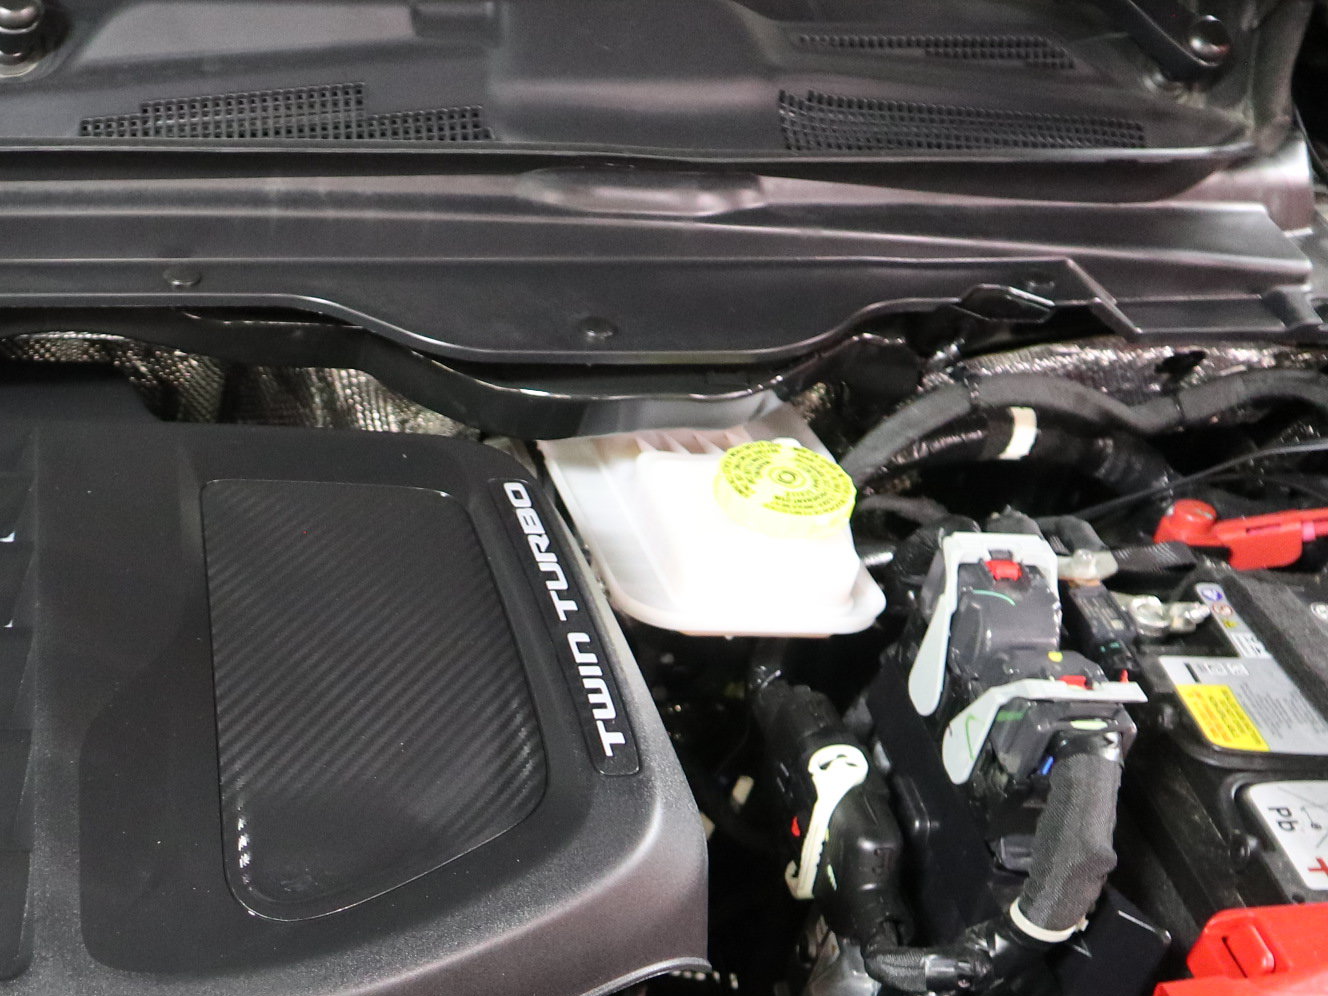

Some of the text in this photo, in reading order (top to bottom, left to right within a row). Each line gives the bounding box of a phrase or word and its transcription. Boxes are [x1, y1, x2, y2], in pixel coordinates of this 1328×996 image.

[503, 481, 627, 757] TWIN TURBO
[1268, 807, 1299, 832] Pb
